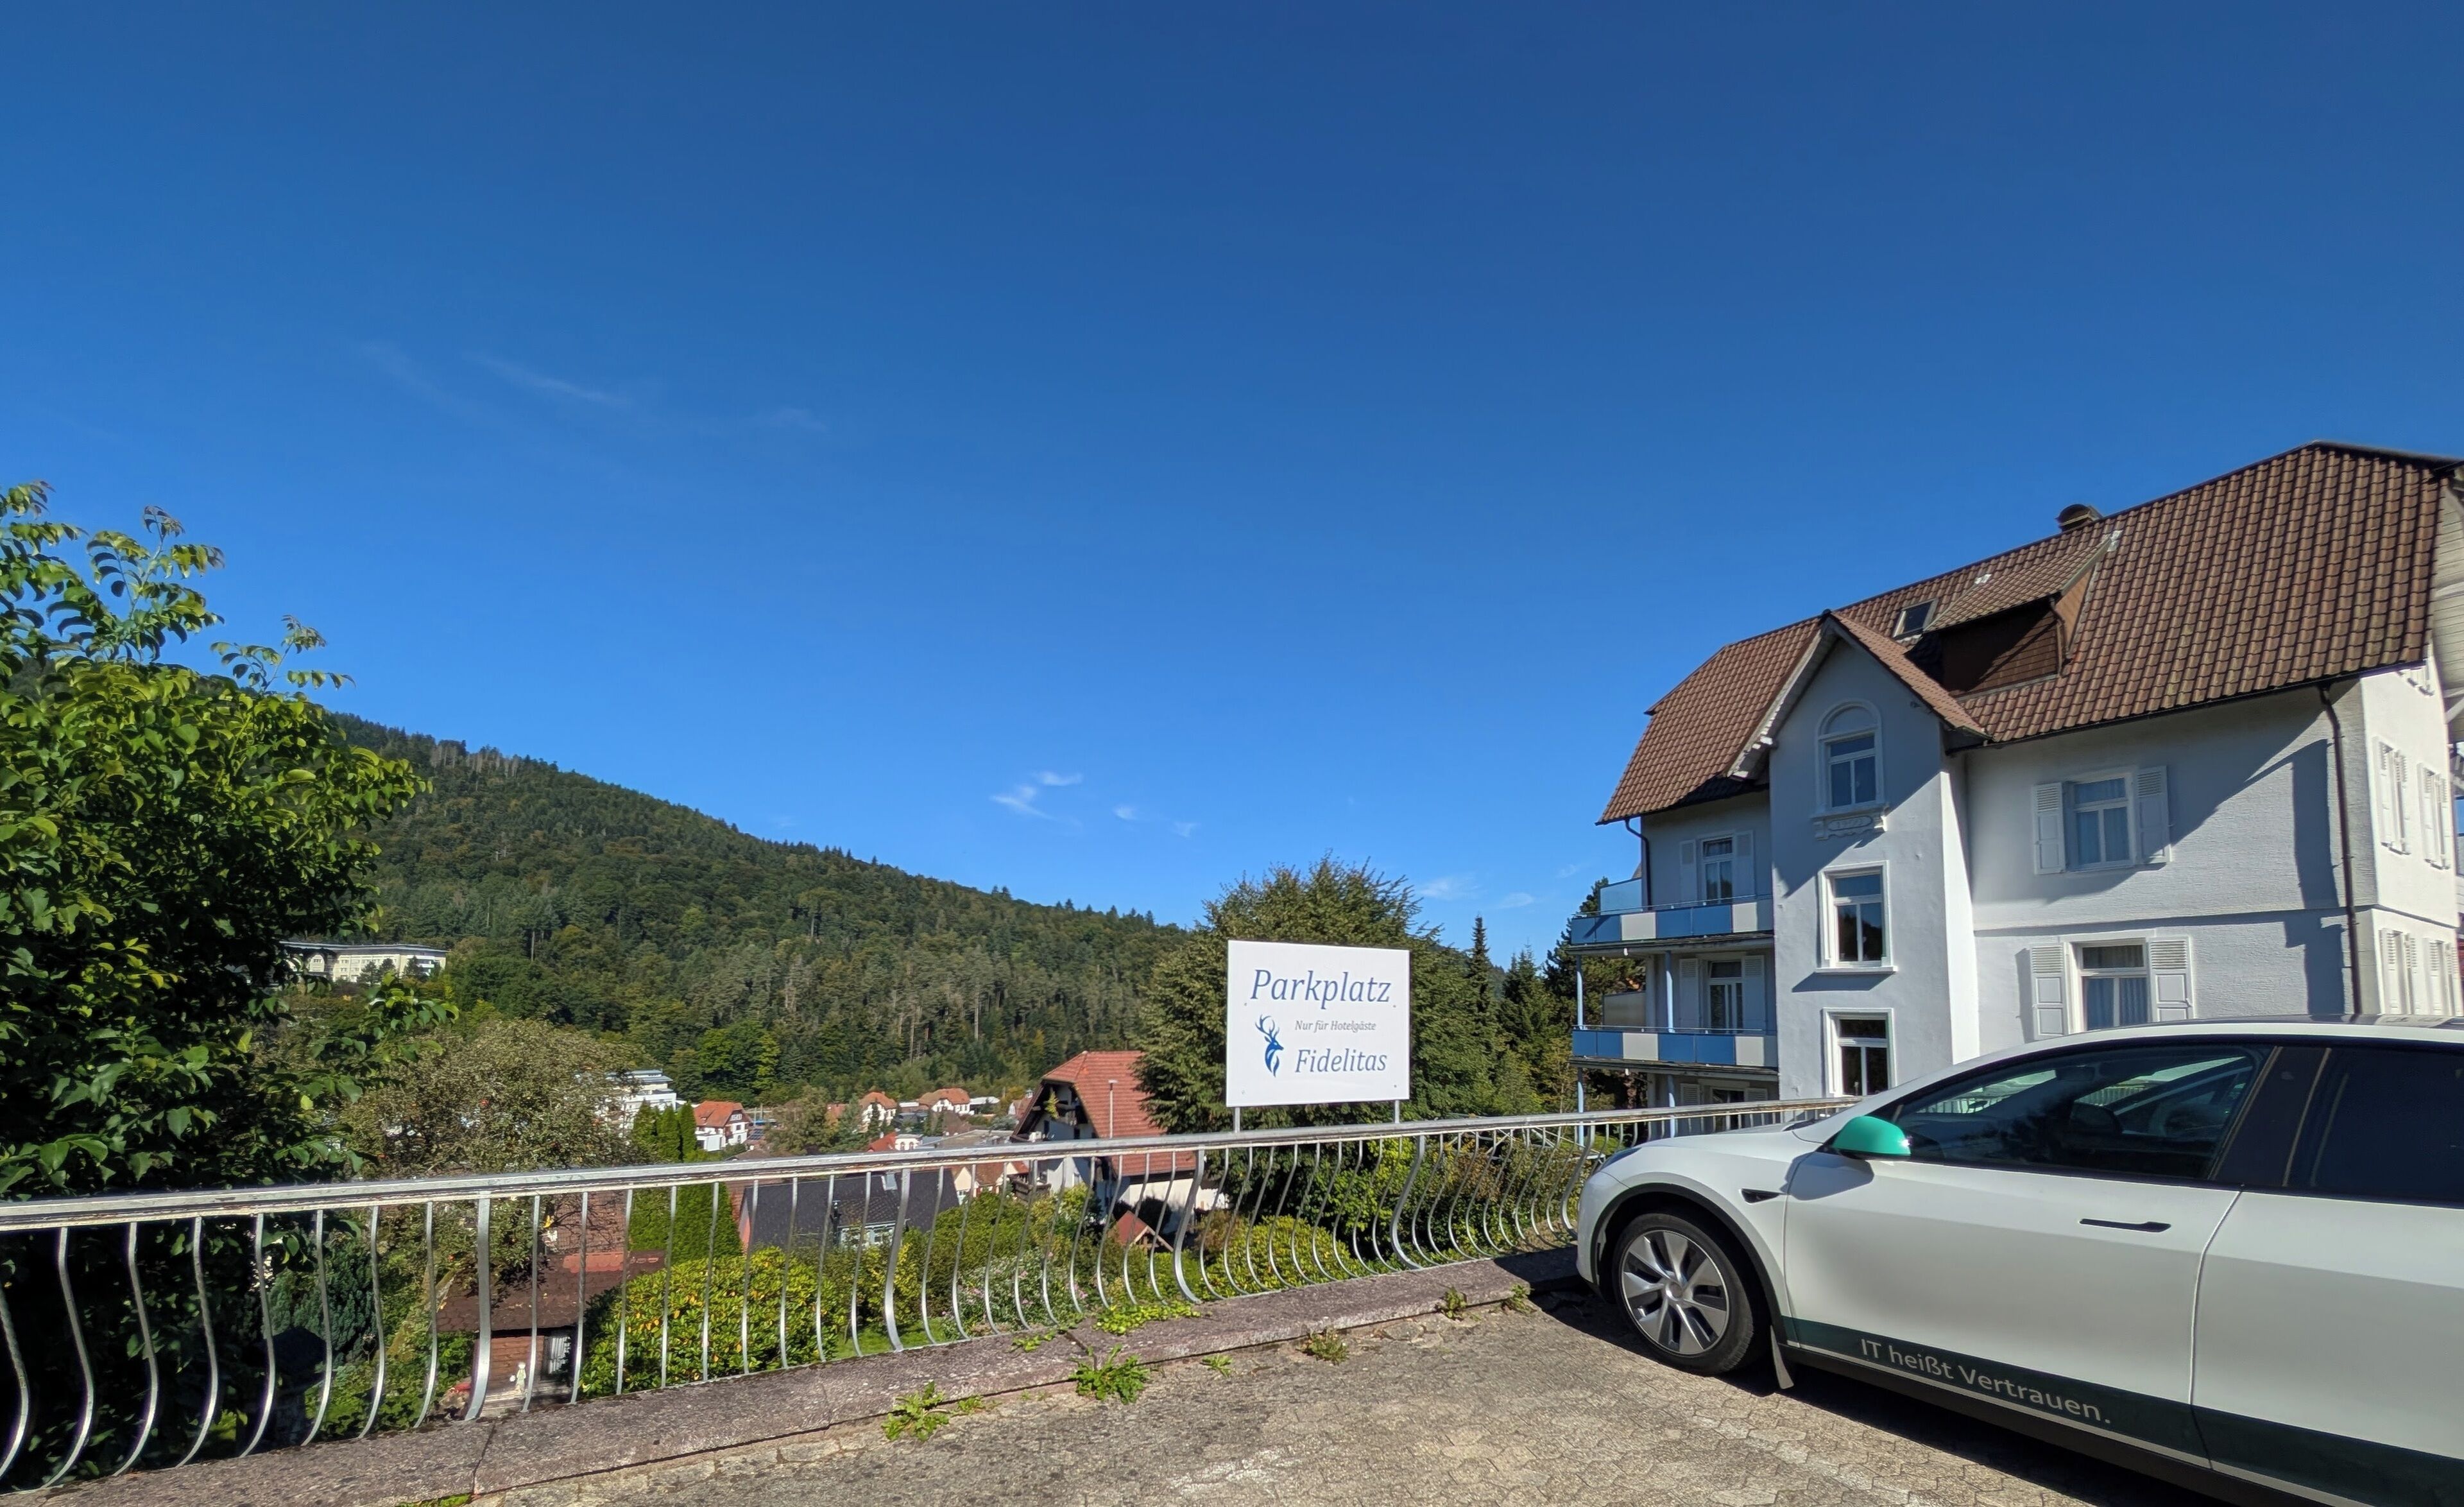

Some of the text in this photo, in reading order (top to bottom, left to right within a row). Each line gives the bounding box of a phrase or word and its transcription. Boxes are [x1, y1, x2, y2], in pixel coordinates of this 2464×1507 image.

[1250, 969, 1392, 1010] Parkplatz
[1295, 1020, 1376, 1033] Nur für Hotelgäste
[1295, 1048, 1387, 1072] Fidelitas
[1861, 1338, 2111, 1424] IT heißt Vertrauen.
